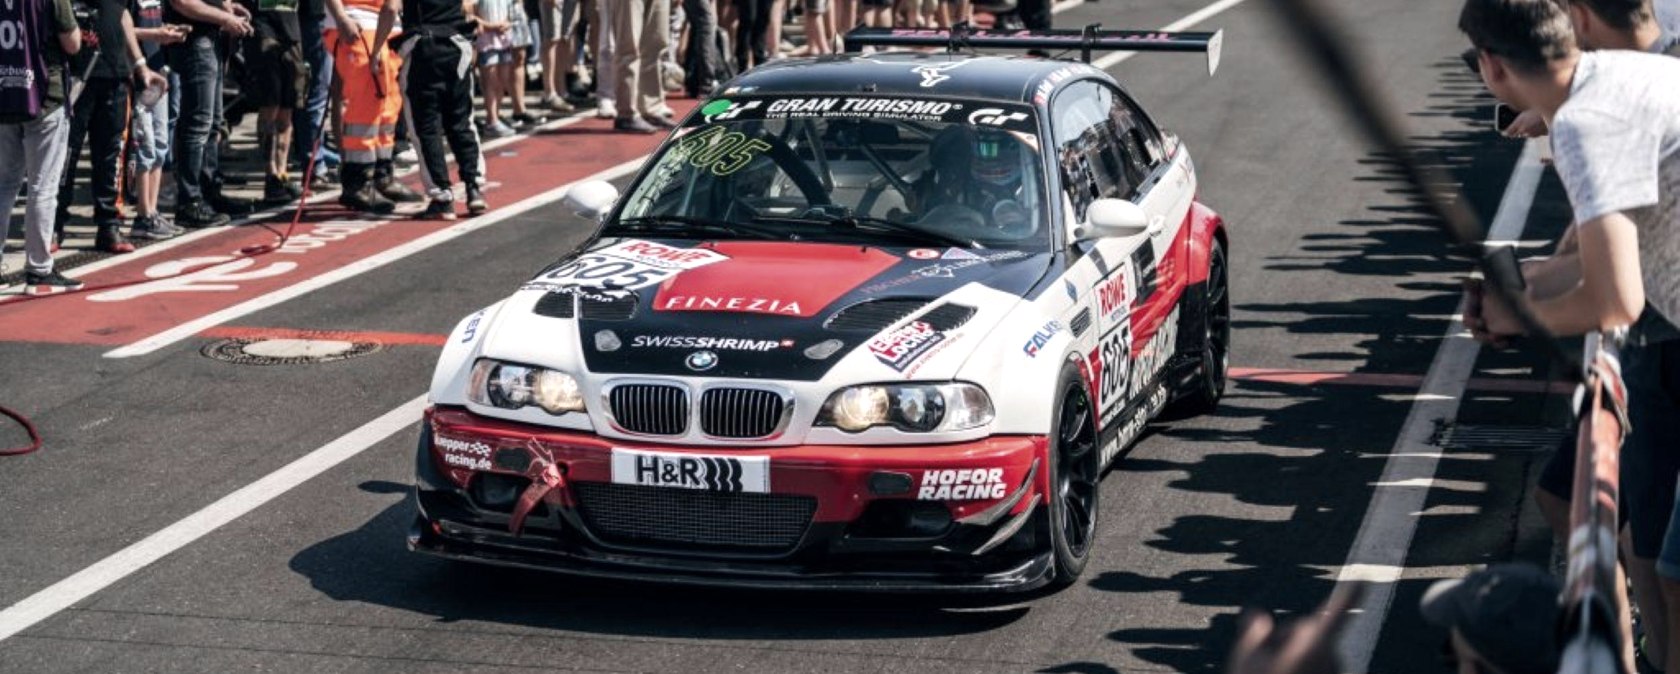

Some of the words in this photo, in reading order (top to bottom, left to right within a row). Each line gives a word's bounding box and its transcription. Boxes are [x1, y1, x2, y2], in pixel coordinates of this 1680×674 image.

[766, 98, 839, 112] GRAN
[873, 112, 942, 121] SIMULATOR
[674, 125, 773, 176] 605
[622, 242, 711, 263] ROWE
[546, 256, 671, 292] 605
[1099, 273, 1126, 317] ROWE
[665, 296, 802, 315] FINEZIA
[1101, 325, 1130, 406] 605
[445, 453, 492, 470] racing.de
[635, 455, 702, 487] H&R
[921, 467, 1004, 486] HOFOR
[917, 483, 1008, 500] RACING
